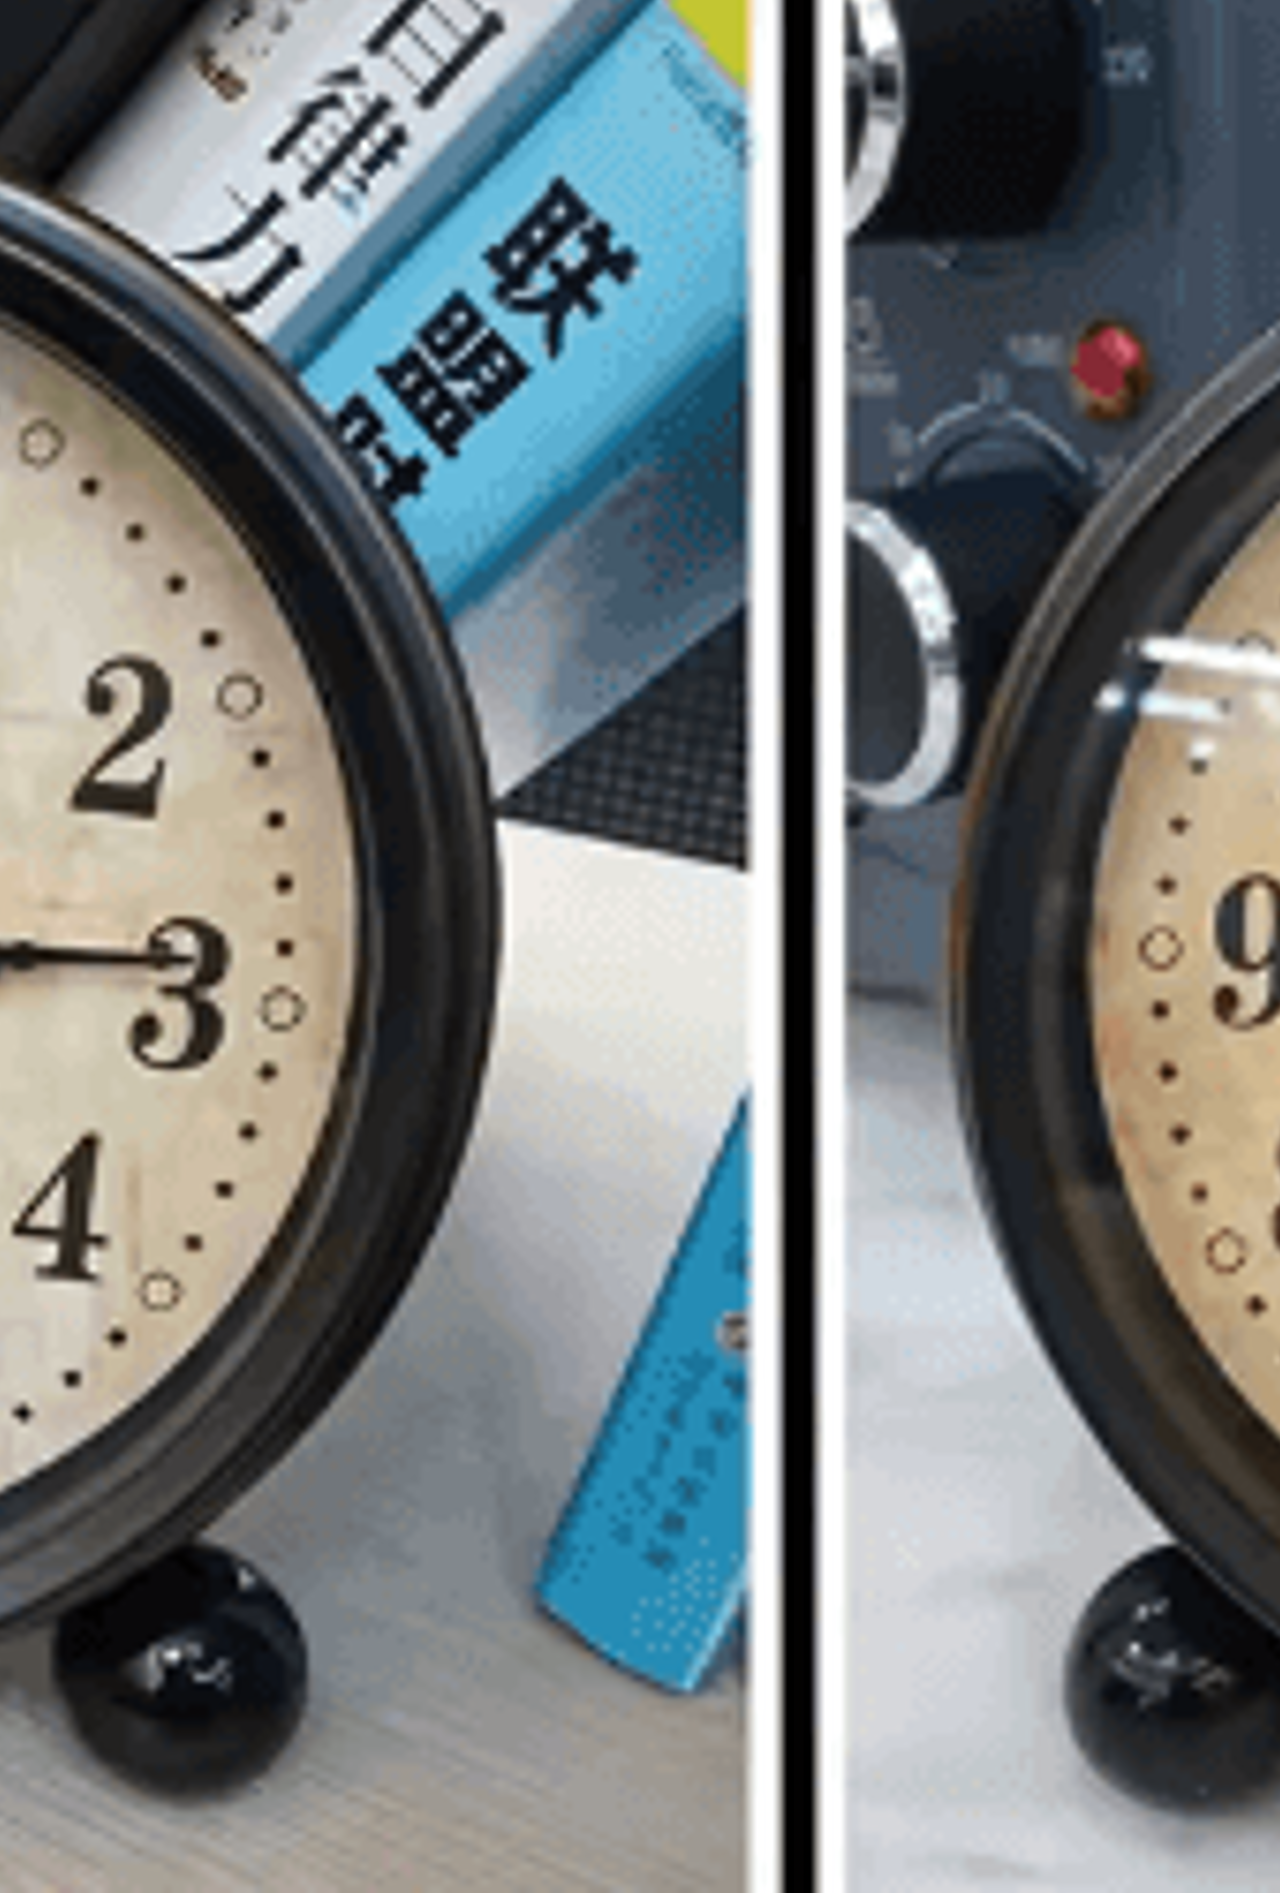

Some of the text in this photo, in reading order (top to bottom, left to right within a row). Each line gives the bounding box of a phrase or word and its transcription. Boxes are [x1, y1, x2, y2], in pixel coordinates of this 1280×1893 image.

[70, 654, 174, 820] 2
[128, 915, 232, 1071] 3
[10, 1132, 110, 1283] 4
